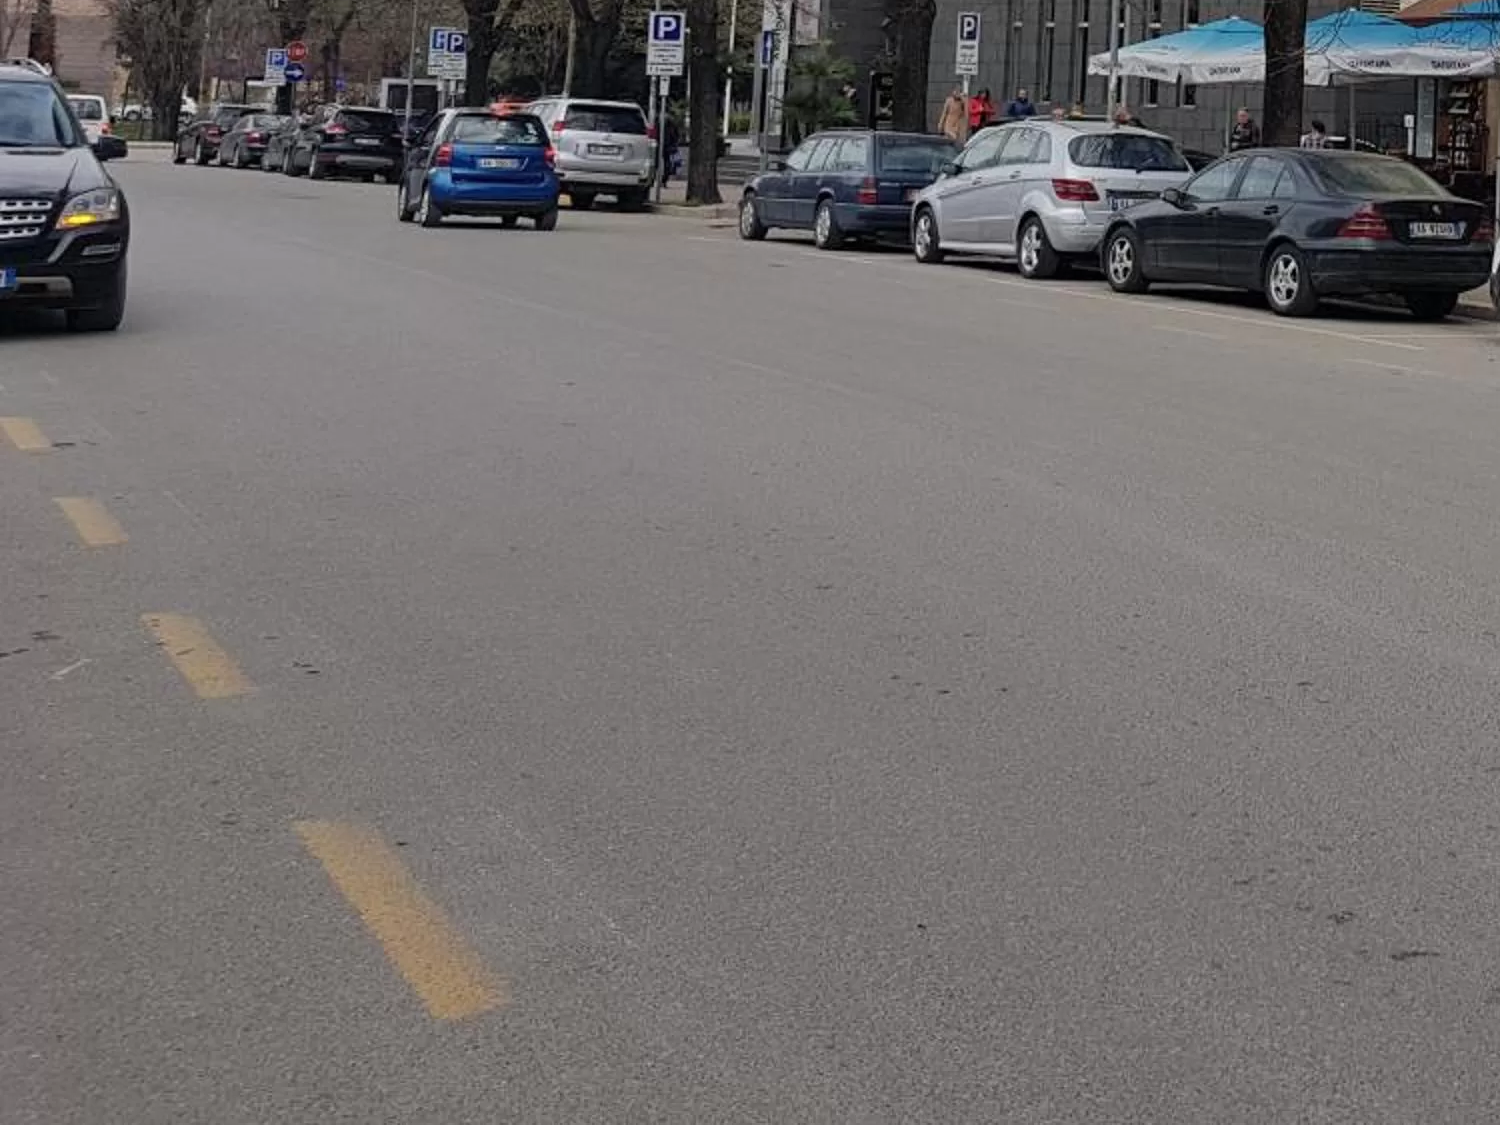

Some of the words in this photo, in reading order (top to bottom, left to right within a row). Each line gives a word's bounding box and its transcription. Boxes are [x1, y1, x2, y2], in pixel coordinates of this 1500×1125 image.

[658, 16, 677, 39] P
[963, 16, 975, 38] P
[451, 34, 463, 51] P
